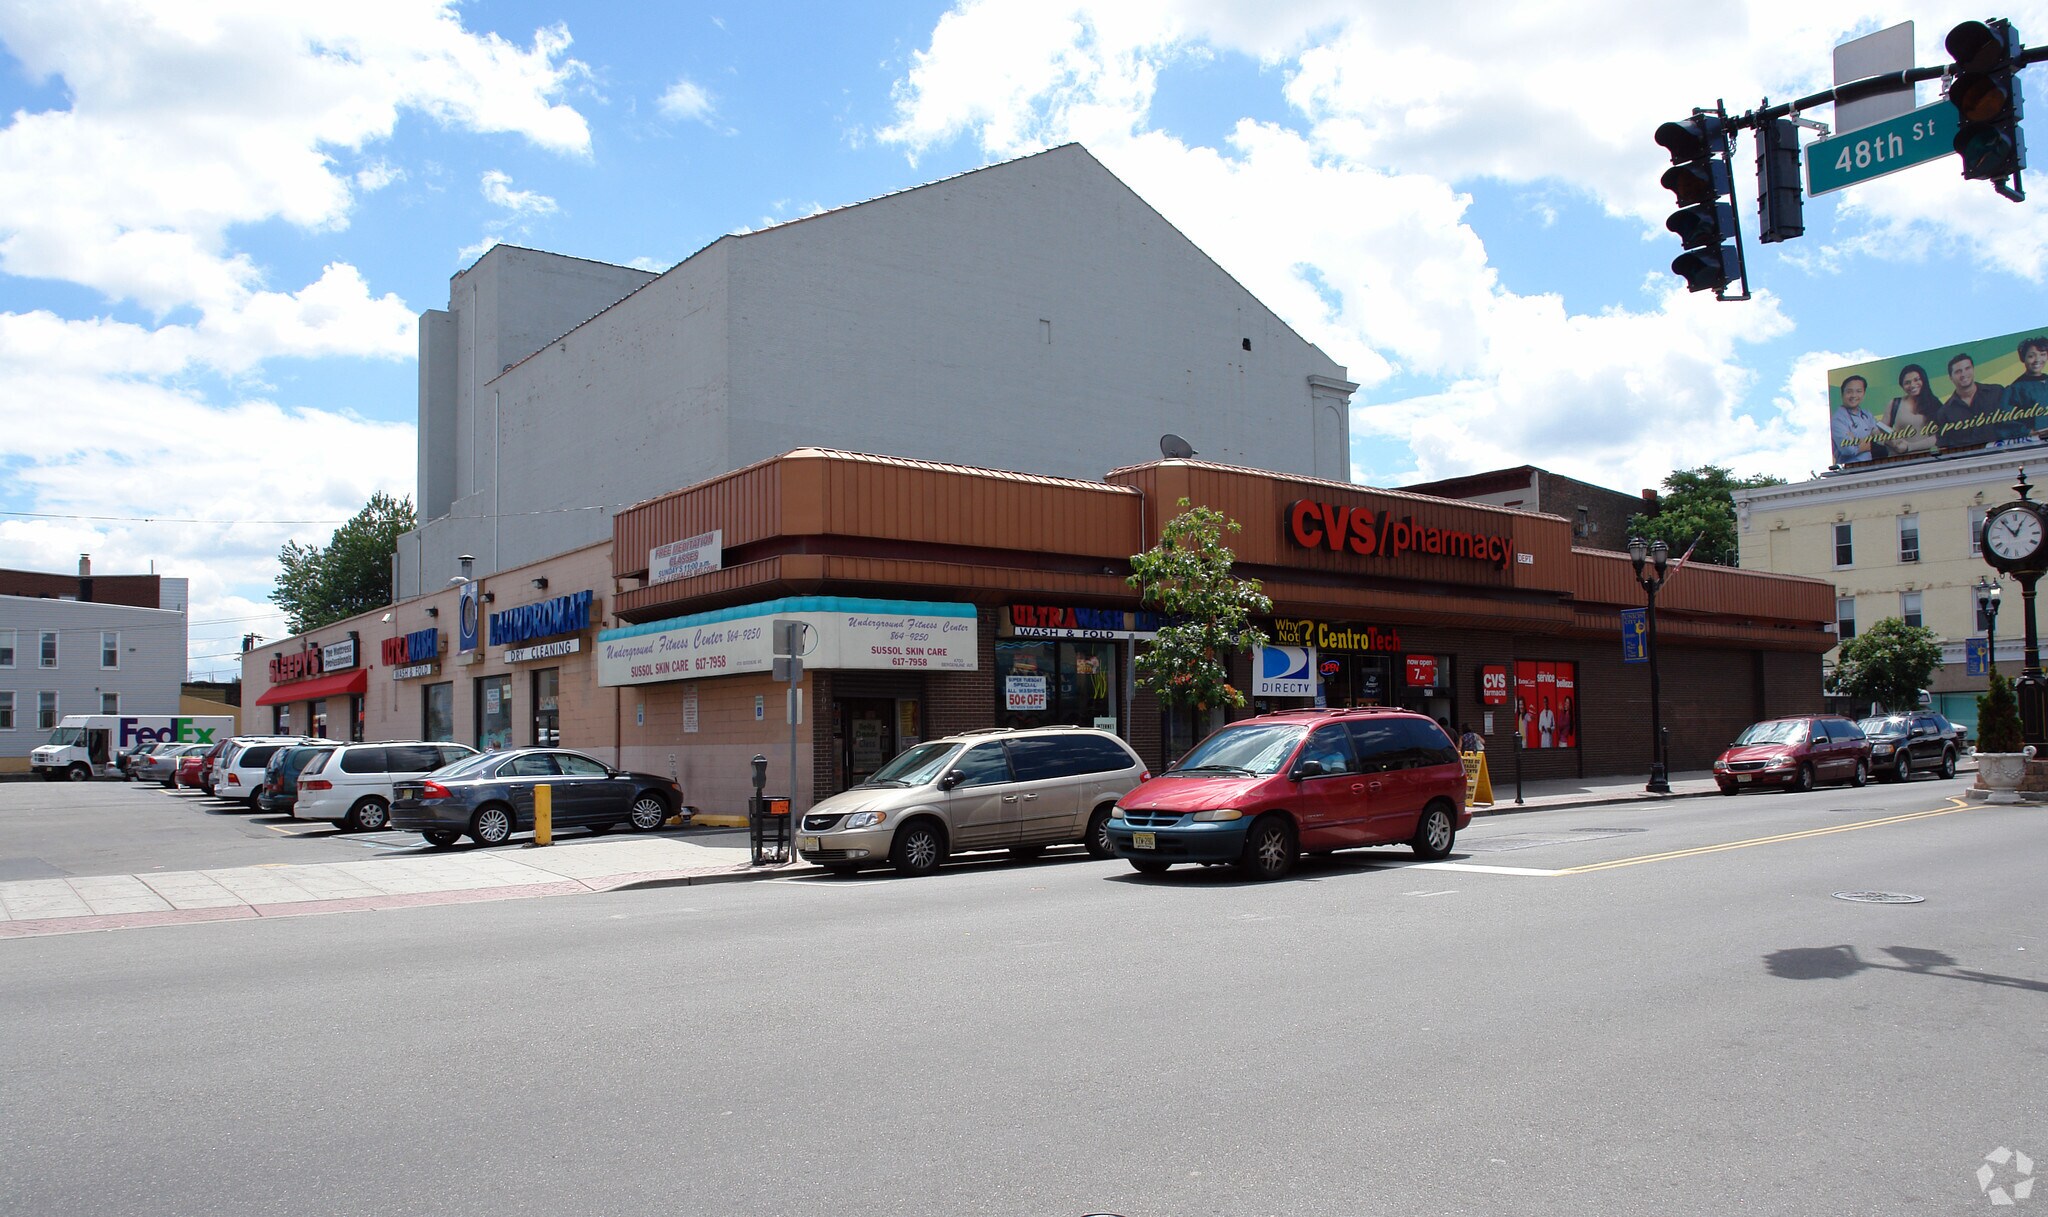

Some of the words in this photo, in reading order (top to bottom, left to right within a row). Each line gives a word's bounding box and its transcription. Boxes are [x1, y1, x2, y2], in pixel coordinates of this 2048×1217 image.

[1834, 131, 1904, 173] 48th
[1912, 118, 1936, 141] St
[1840, 437, 1860, 448] un
[1863, 424, 1916, 446] mundo
[1920, 420, 1939, 437] de
[1291, 499, 1513, 570] CVS/pharmacy
[655, 544, 672, 560] FREE
[672, 532, 714, 556] MEDITATION
[669, 550, 699, 567] CLASSES
[683, 561, 699, 572] 11:00
[489, 590, 593, 646] LAUNDROMAT
[848, 617, 904, 630] Underground
[907, 618, 938, 630] Fitness
[942, 621, 969, 633] Center
[1274, 618, 1299, 633] Why
[890, 631, 929, 642] 864-9250
[1020, 627, 1059, 637] WASH
[1066, 628, 1075, 638] &
[1083, 630, 1115, 639] FOLD
[1278, 632, 1300, 643] Not
[1318, 622, 1401, 652] CentroTech
[510, 649, 525, 661] DRY
[531, 641, 571, 659] CLEANING
[606, 639, 654, 661] Underground
[658, 635, 689, 654] Fitness
[693, 628, 724, 650] Center
[726, 627, 762, 643] 864-9250
[871, 646, 903, 655] SUSSOL
[905, 647, 924, 656] SKIN
[927, 647, 948, 656] CARE
[269, 645, 321, 683] SLEEPY'S
[630, 665, 654, 678] SUSSOL
[655, 661, 670, 675] SKIN
[671, 659, 689, 673] CARE
[695, 655, 727, 670] 617-7958
[892, 658, 928, 667] 617-7958
[1320, 661, 1340, 673] OPEN
[1419, 659, 1433, 668] open
[1483, 673, 1506, 688] CVS
[1537, 672, 1555, 683] service
[1262, 682, 1310, 693] DIRECTV
[1483, 688, 1506, 697] farmacia
[1027, 694, 1045, 705] OFF
[120, 718, 216, 747] FedEx
